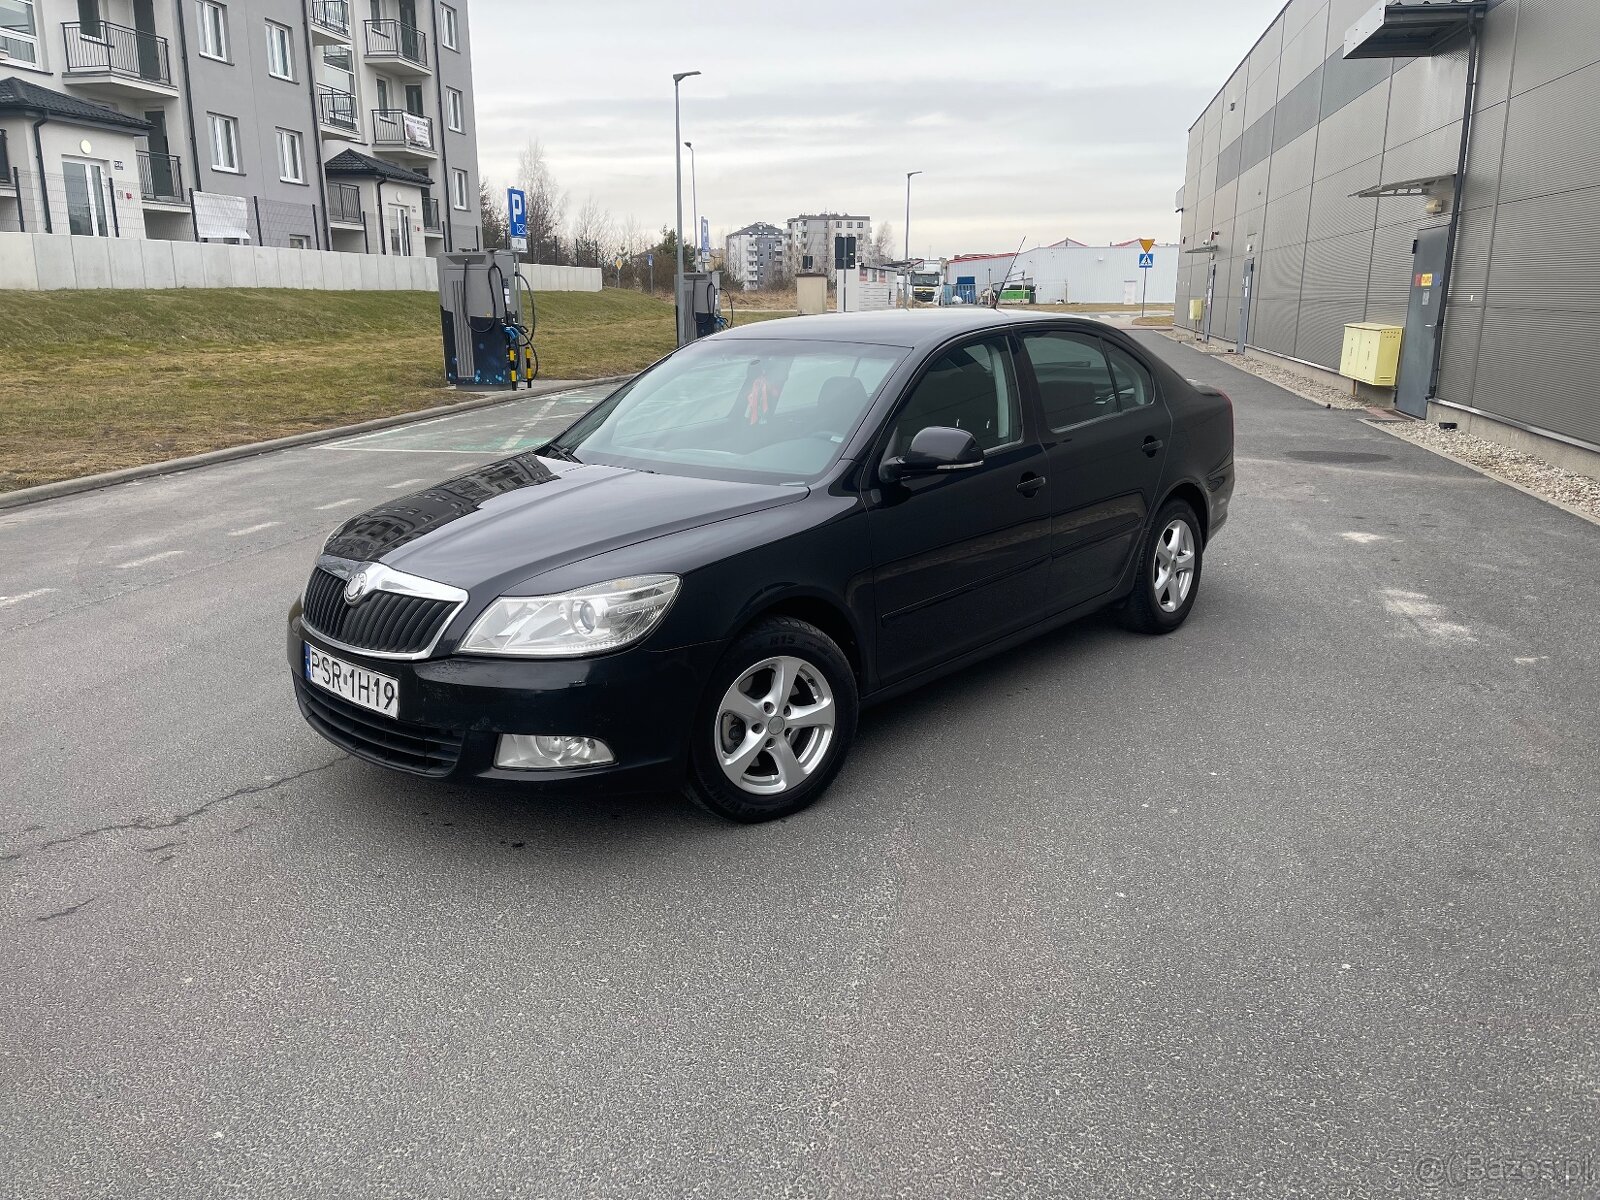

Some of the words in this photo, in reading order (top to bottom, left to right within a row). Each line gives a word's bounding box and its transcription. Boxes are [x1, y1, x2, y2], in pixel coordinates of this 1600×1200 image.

[511, 193, 523, 223] P
[311, 650, 342, 692] PSR
[349, 669, 395, 711] 1H19
